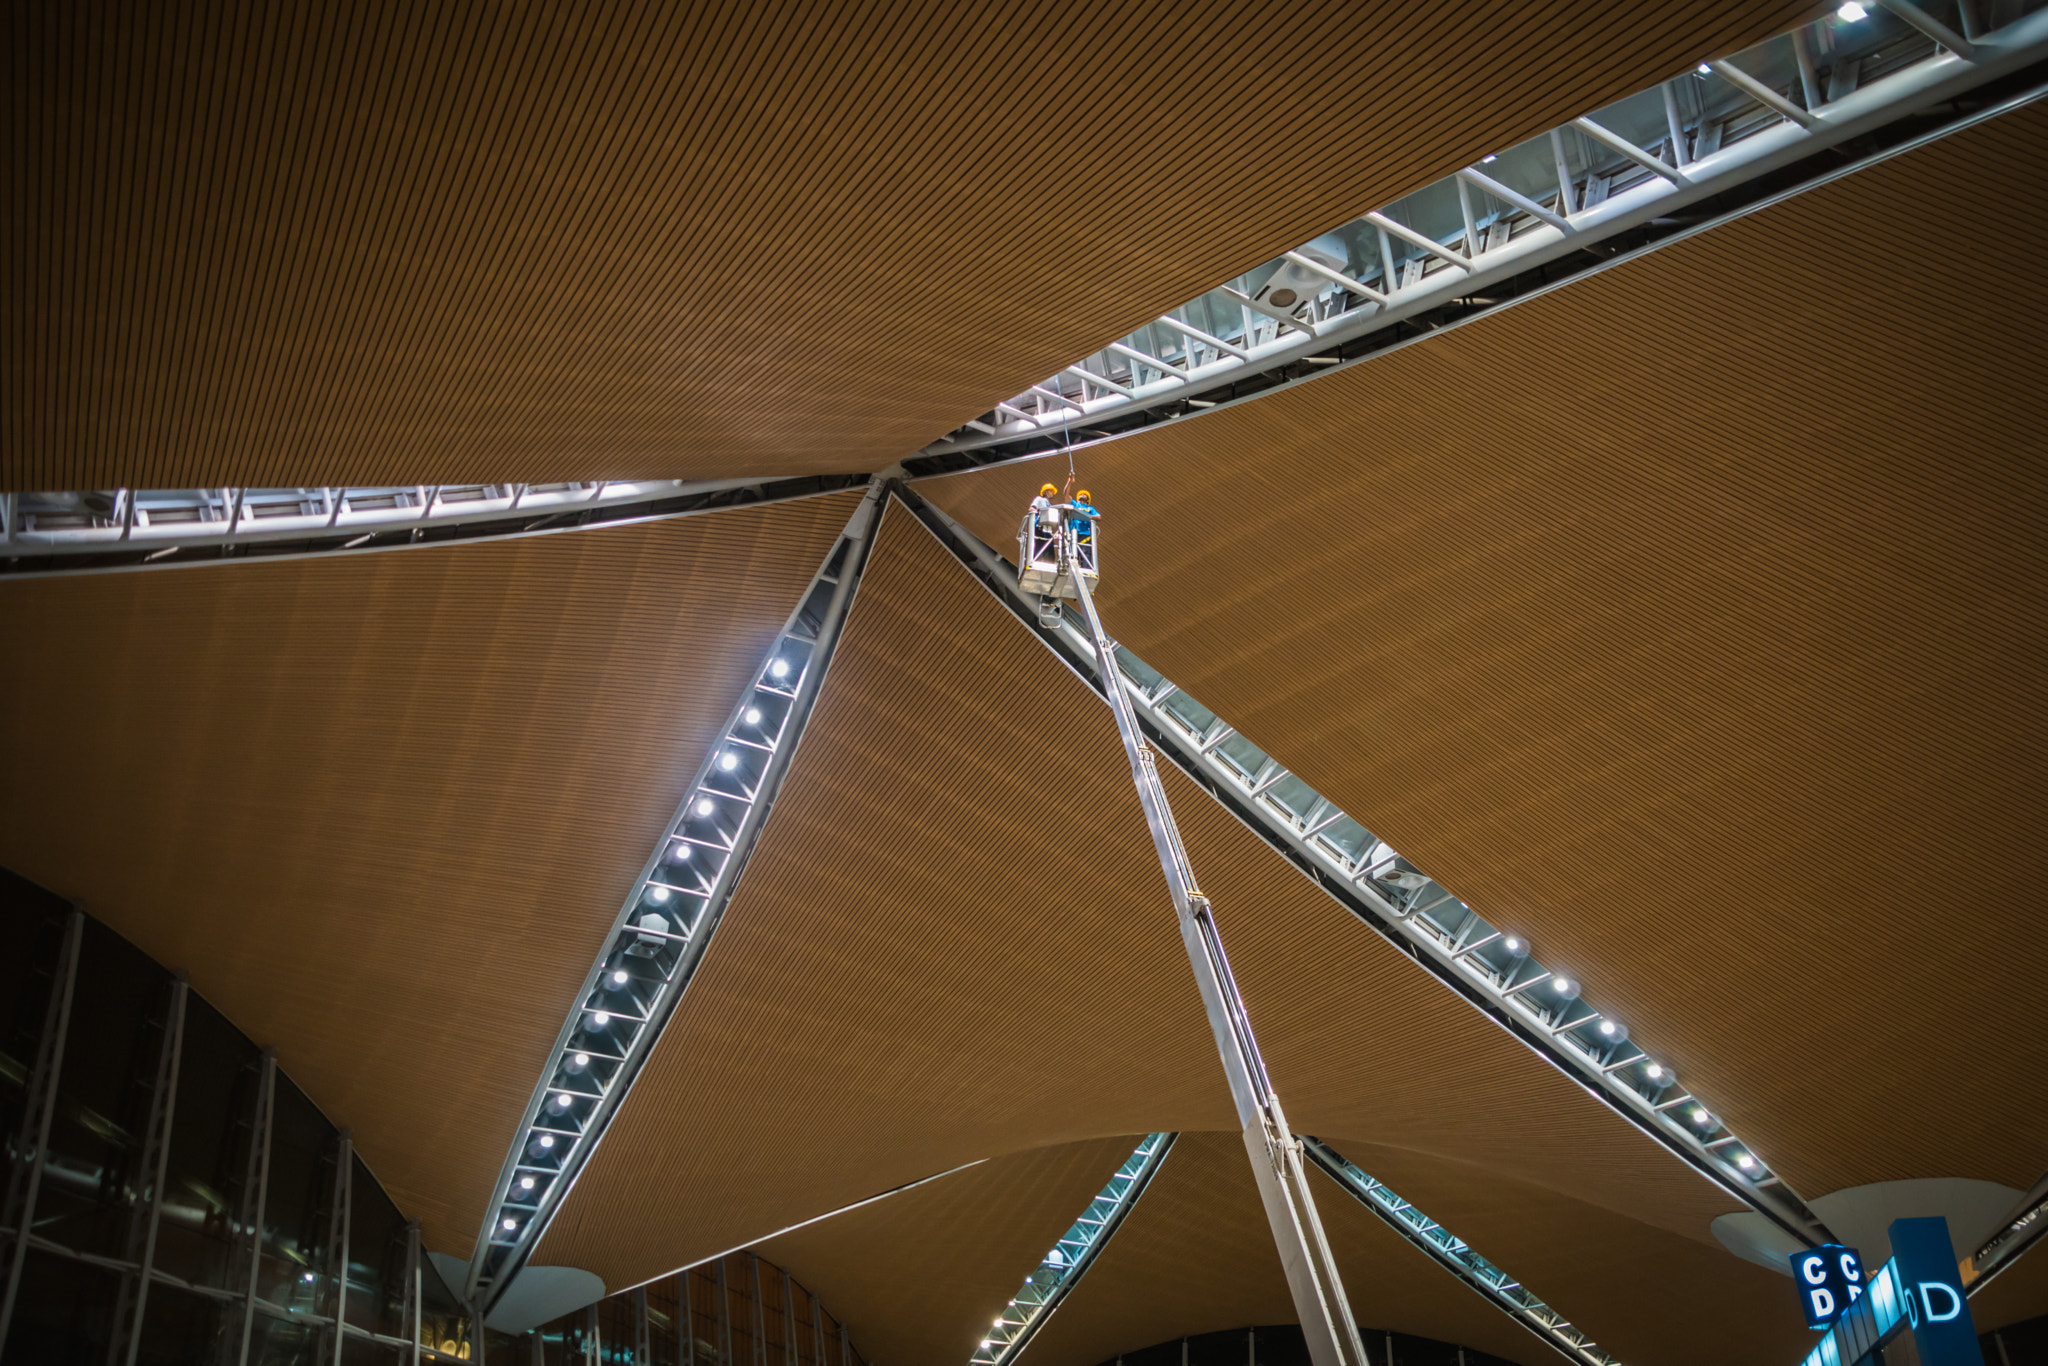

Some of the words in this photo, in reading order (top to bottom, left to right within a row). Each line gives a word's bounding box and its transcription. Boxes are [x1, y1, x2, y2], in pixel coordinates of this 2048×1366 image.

[1803, 1256, 1827, 1285] C
[1840, 1254, 1859, 1281] C
[1810, 1288, 1835, 1318] D
[1918, 1282, 1960, 1321] D
